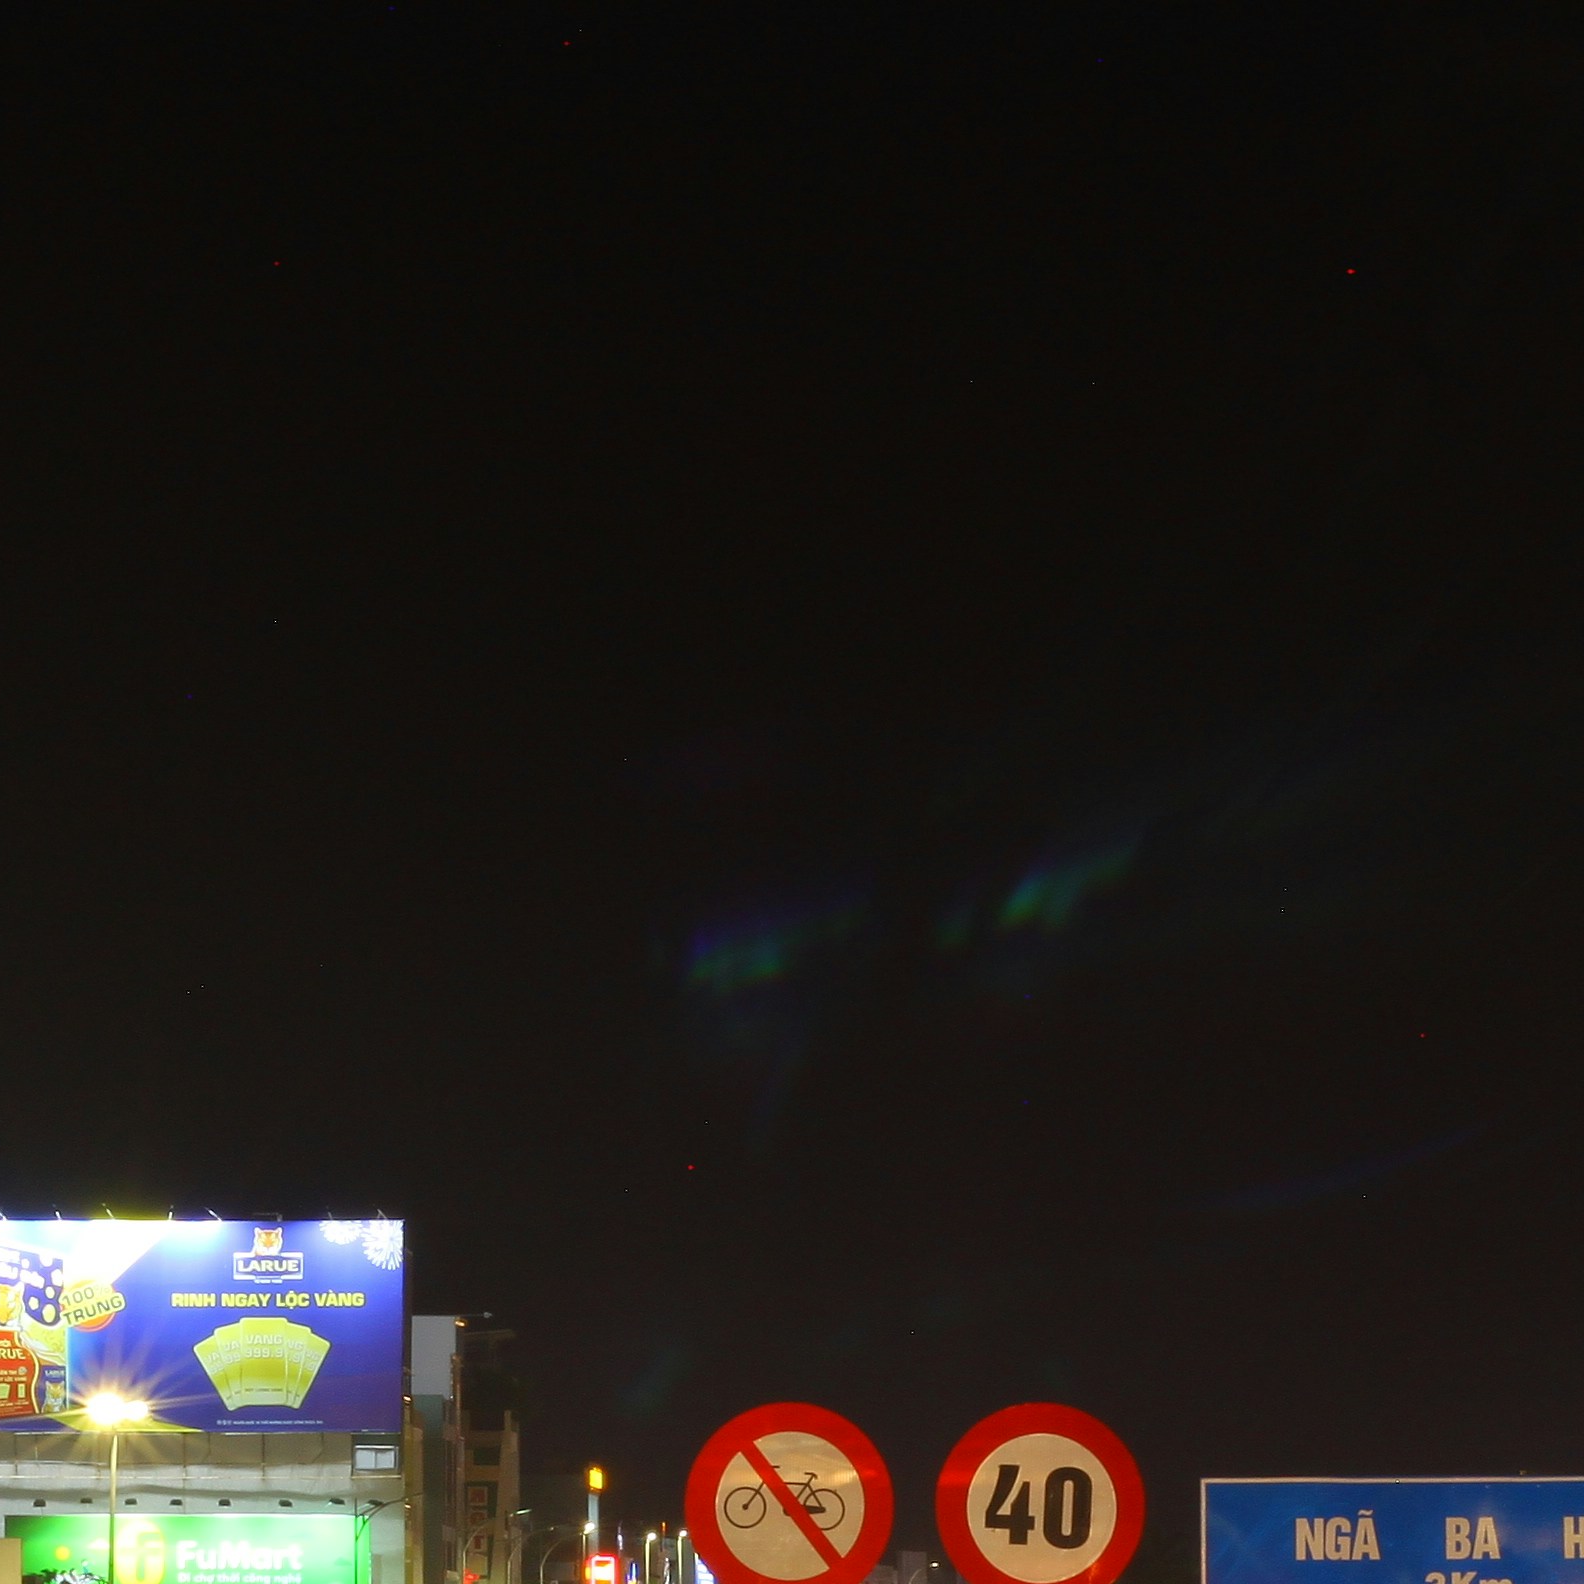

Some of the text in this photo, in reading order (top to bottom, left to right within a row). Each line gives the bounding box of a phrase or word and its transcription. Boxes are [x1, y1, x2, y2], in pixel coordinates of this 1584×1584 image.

[237, 1258, 300, 1273] LARUE
[171, 1289, 366, 1310] RINH NGAY LỘC VÀNG
[984, 1463, 1093, 1549] 40
[1295, 1510, 1380, 1561] NGÃ
[1445, 1517, 1500, 1559] BA
[176, 1539, 303, 1570] FuMart
